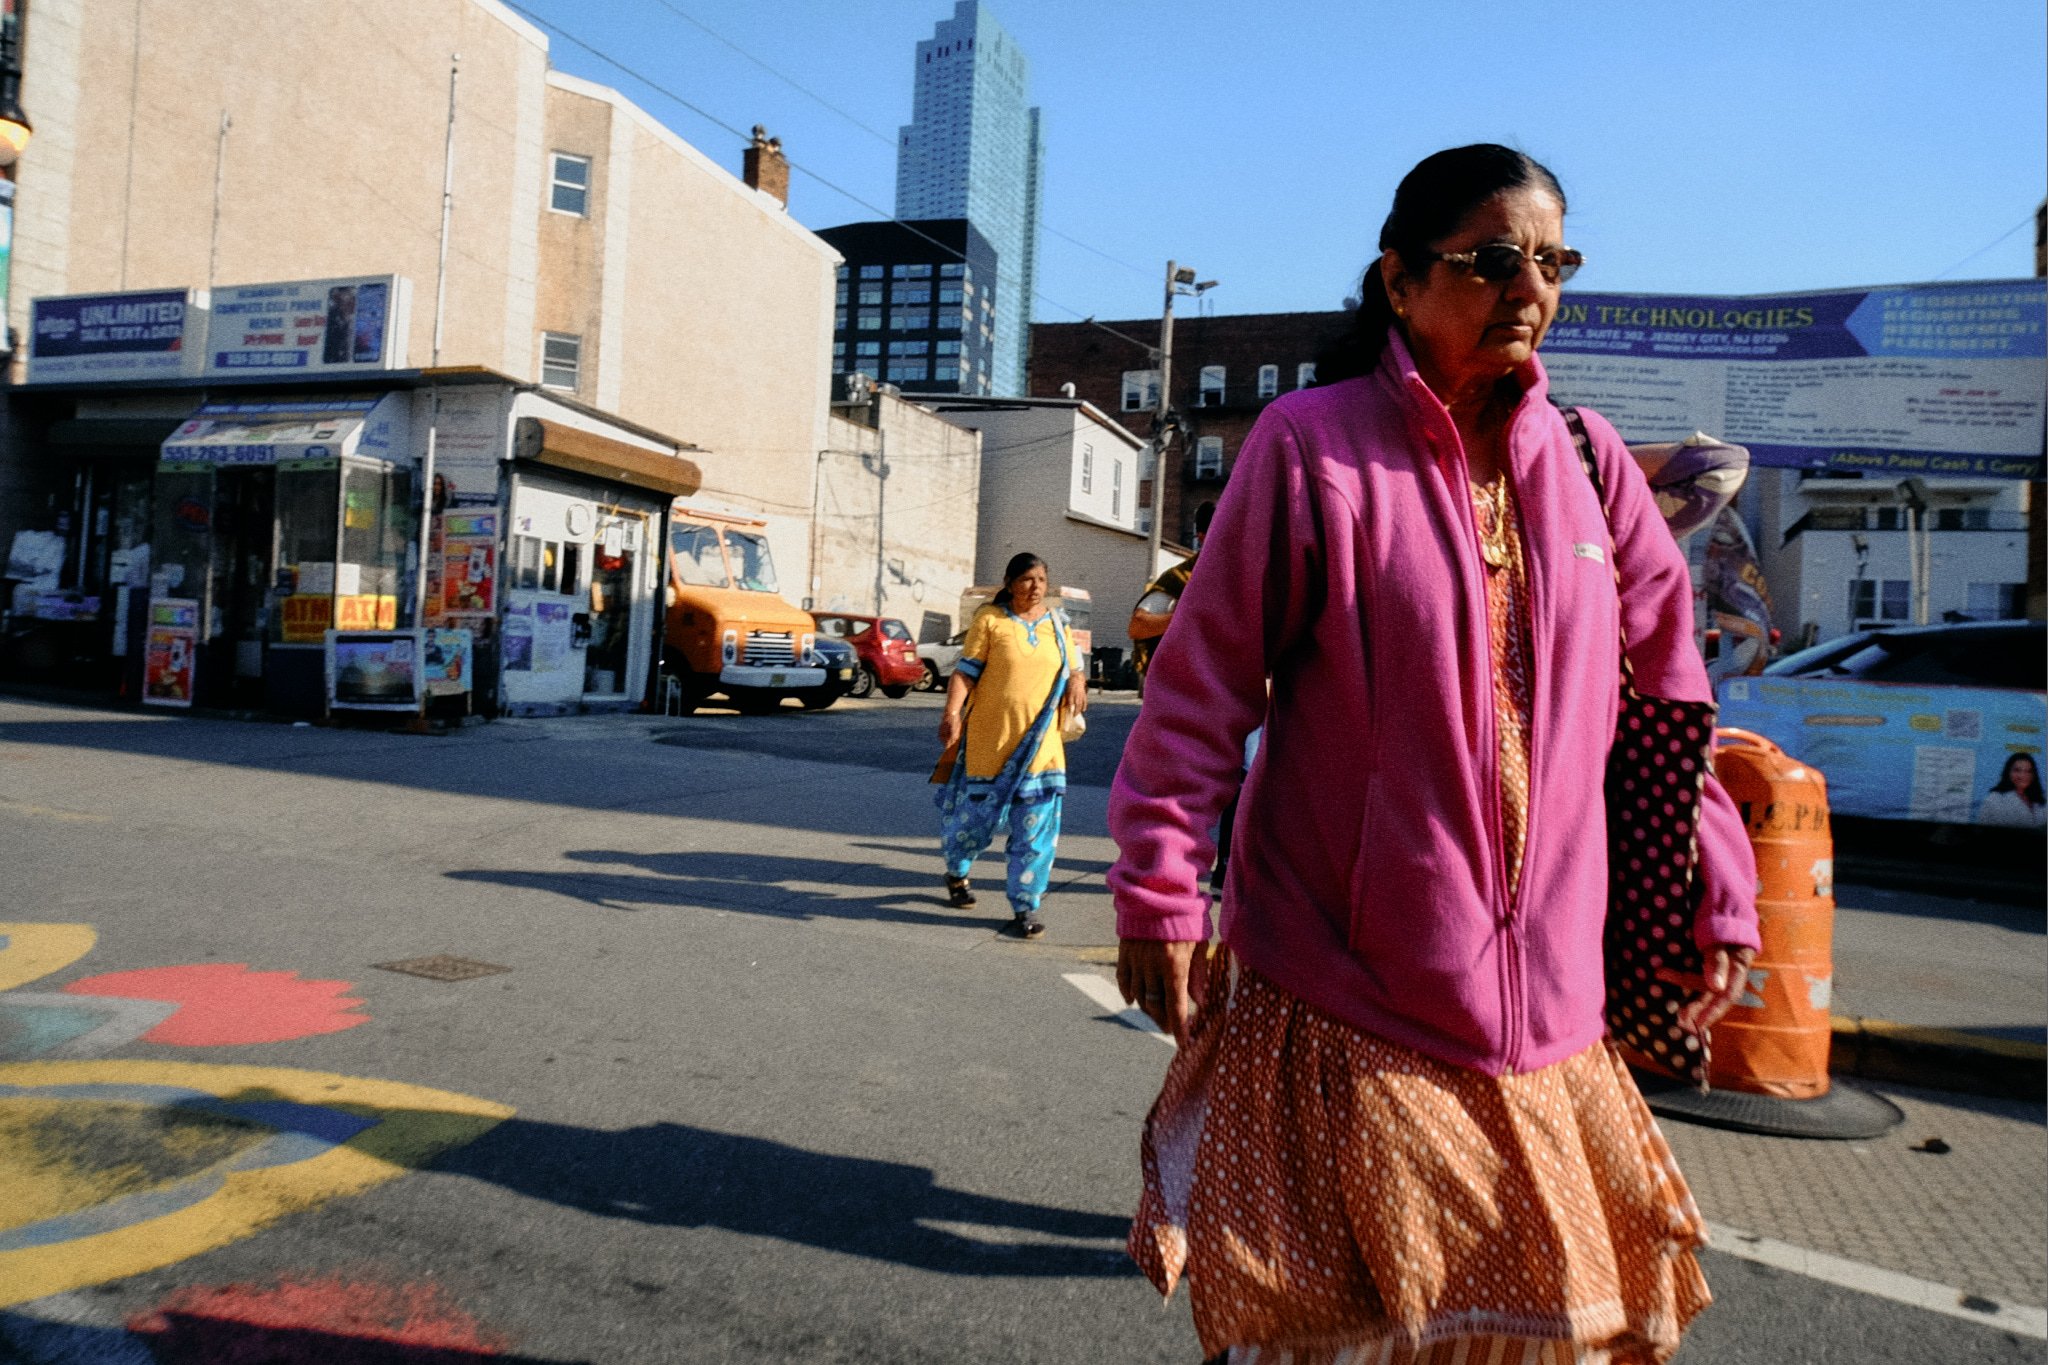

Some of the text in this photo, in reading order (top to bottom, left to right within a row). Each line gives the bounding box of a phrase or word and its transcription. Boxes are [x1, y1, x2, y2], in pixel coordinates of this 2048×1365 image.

[80, 301, 184, 326] UNLIMITED
[1554, 304, 1814, 329] ON TECHNOLOGIES
[1651, 331, 1698, 343] JERSEY
[1733, 334, 1750, 344] NJ
[1930, 456, 1970, 470] Cash
[1974, 459, 1985, 471] &
[284, 598, 331, 621] ATM
[341, 599, 393, 622] ATM
